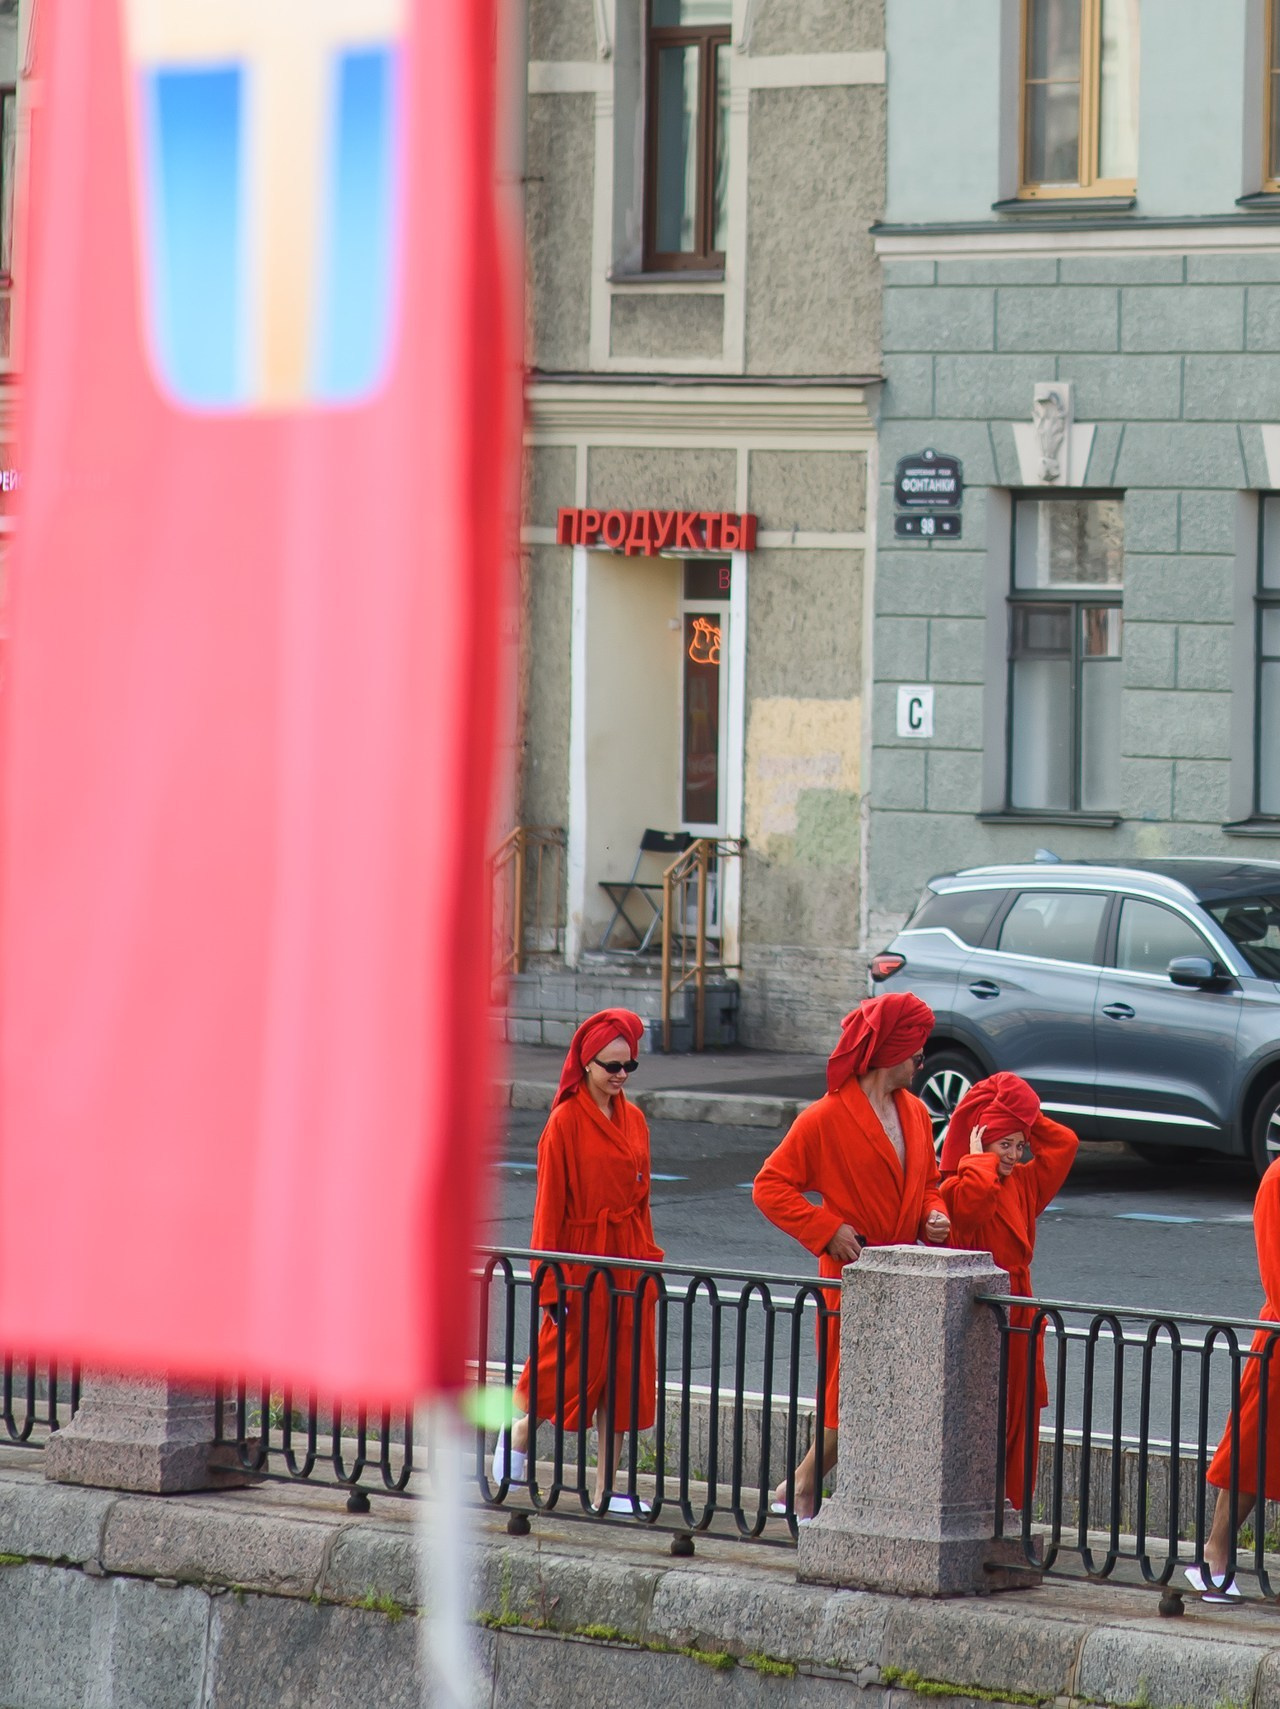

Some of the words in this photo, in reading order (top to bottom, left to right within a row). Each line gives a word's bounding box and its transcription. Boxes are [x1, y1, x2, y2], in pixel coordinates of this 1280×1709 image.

[901, 478, 955, 493] ФОНТАНКИ
[557, 507, 756, 557] ПРОДУКТЫ
[921, 517, 935, 536] 98
